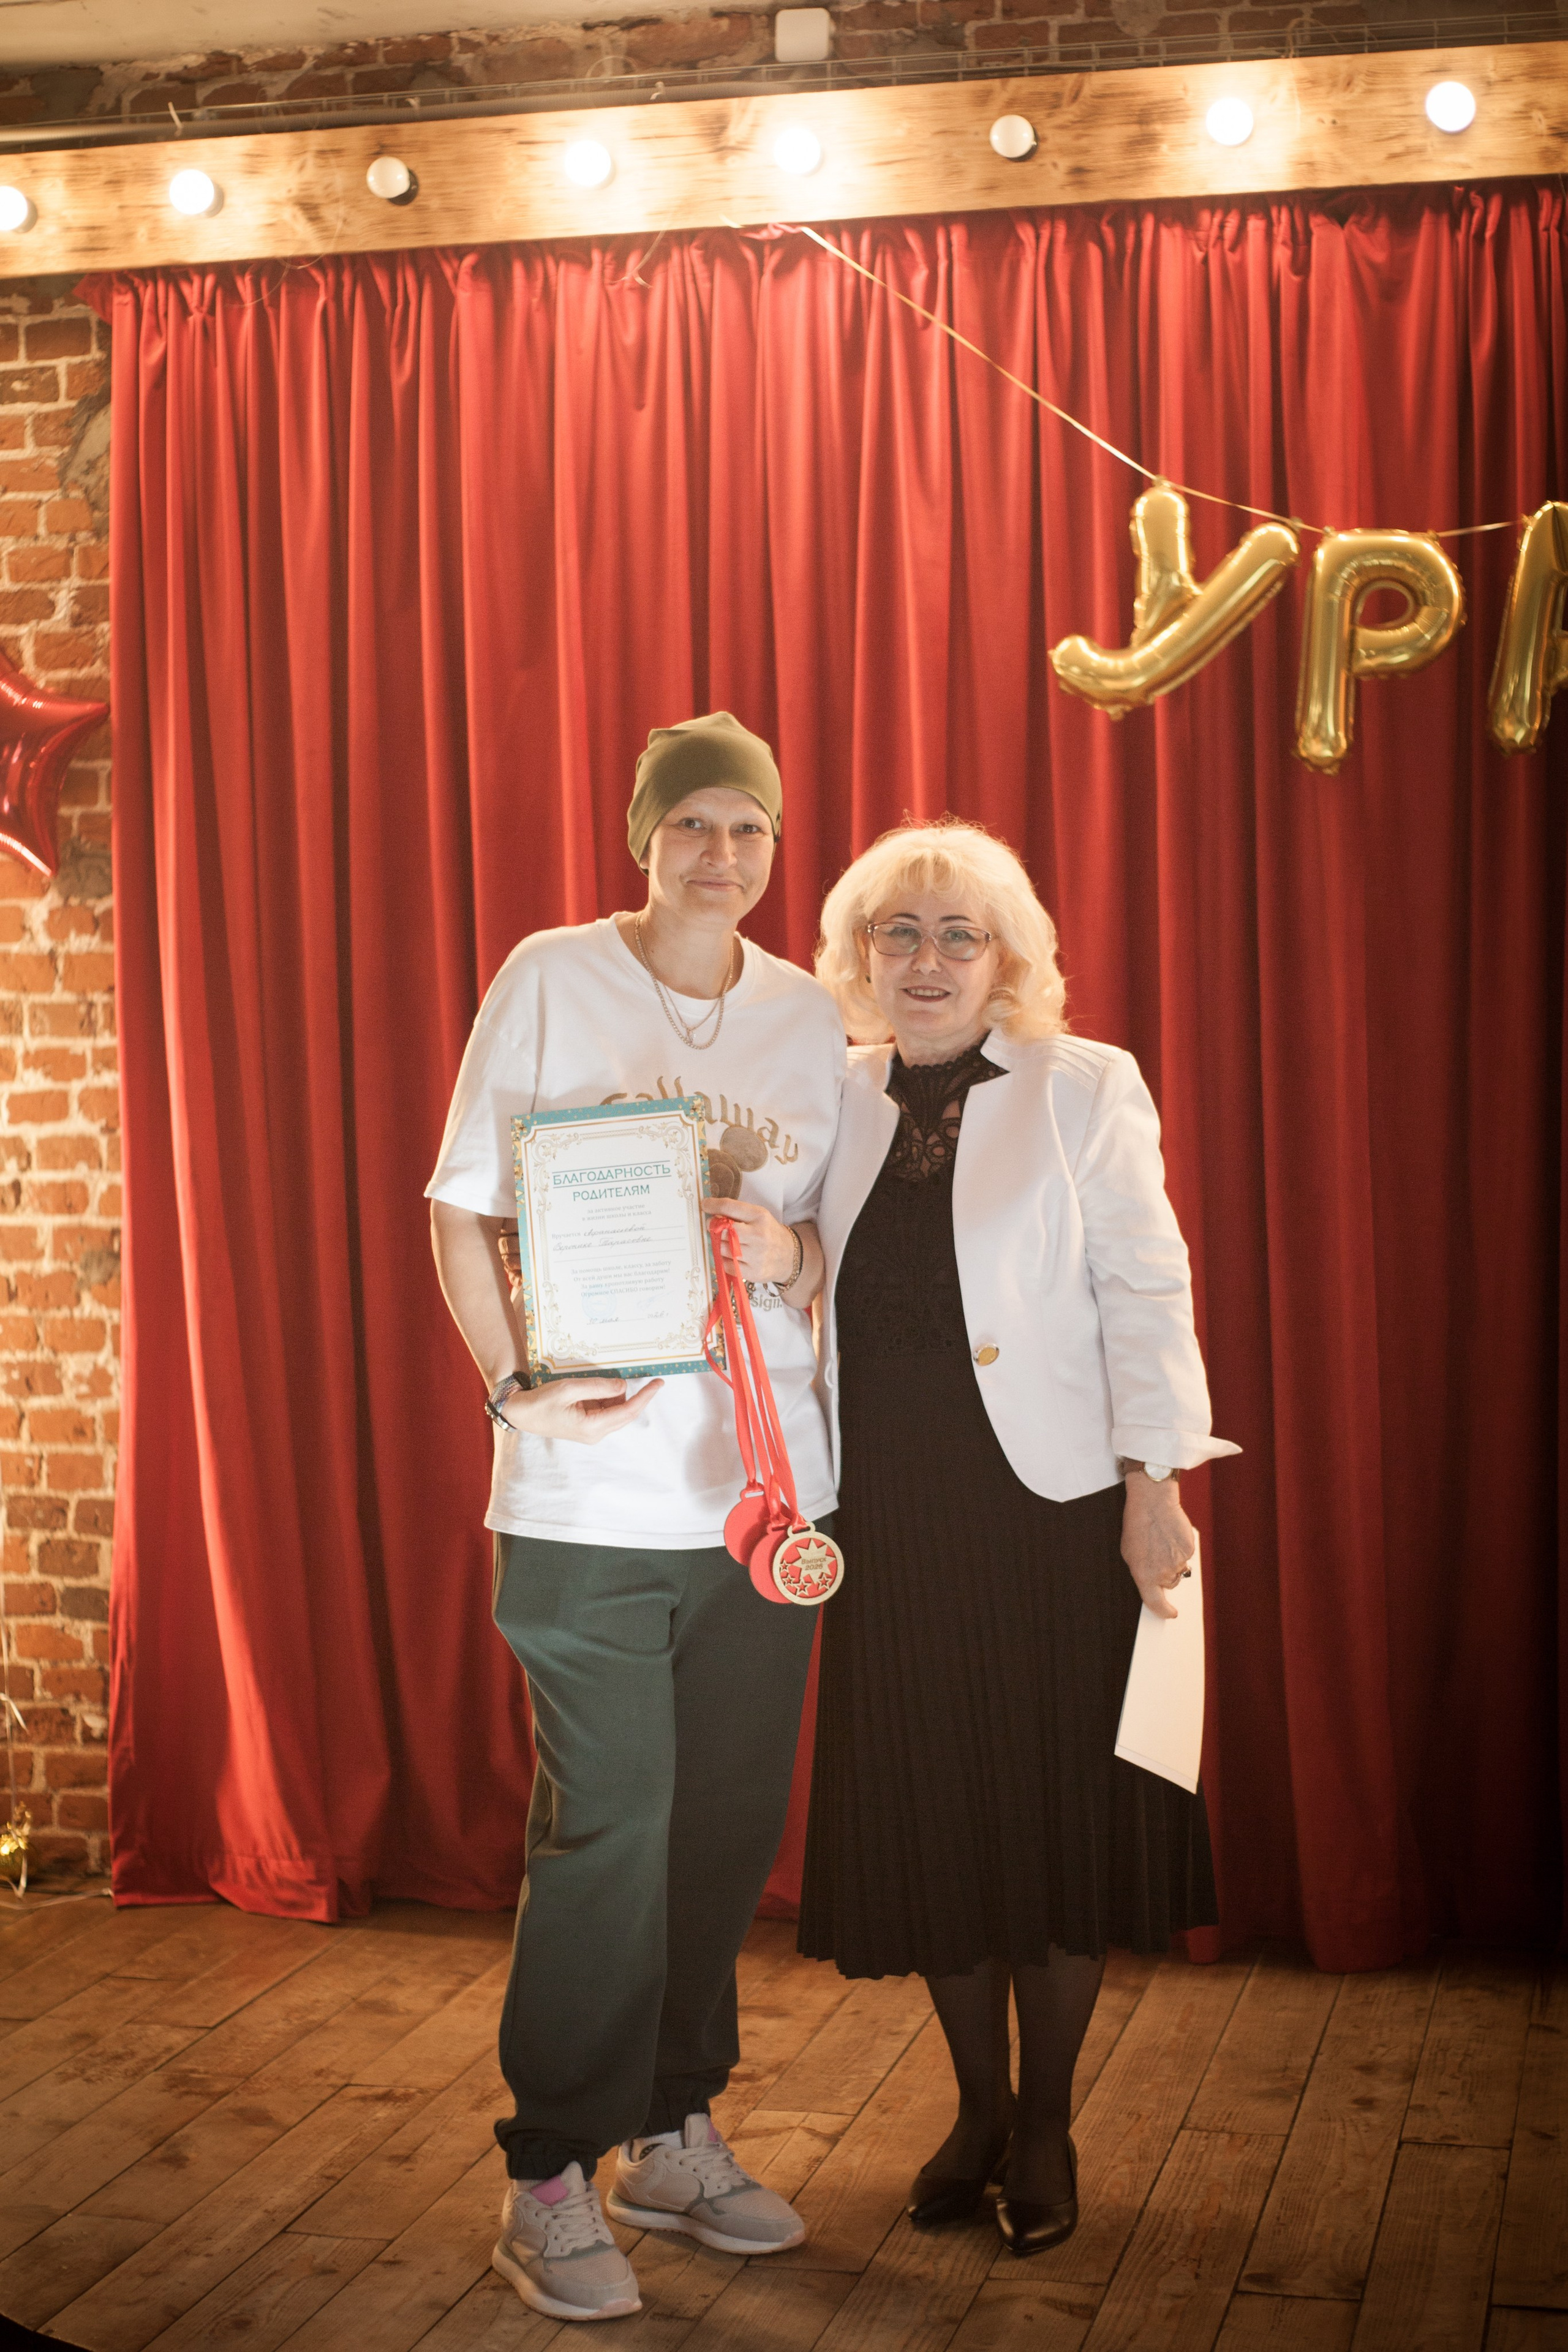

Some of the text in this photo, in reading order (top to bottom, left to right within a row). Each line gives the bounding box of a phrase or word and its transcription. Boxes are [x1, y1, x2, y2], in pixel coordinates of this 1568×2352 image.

[553, 1164, 671, 1185] БЛАГОДАРНОСТЬ
[573, 1185, 650, 1201] РОДИТЕЛЯМ
[634, 1267, 670, 1276] благодарим!
[605, 1279, 643, 1287] кропотливую
